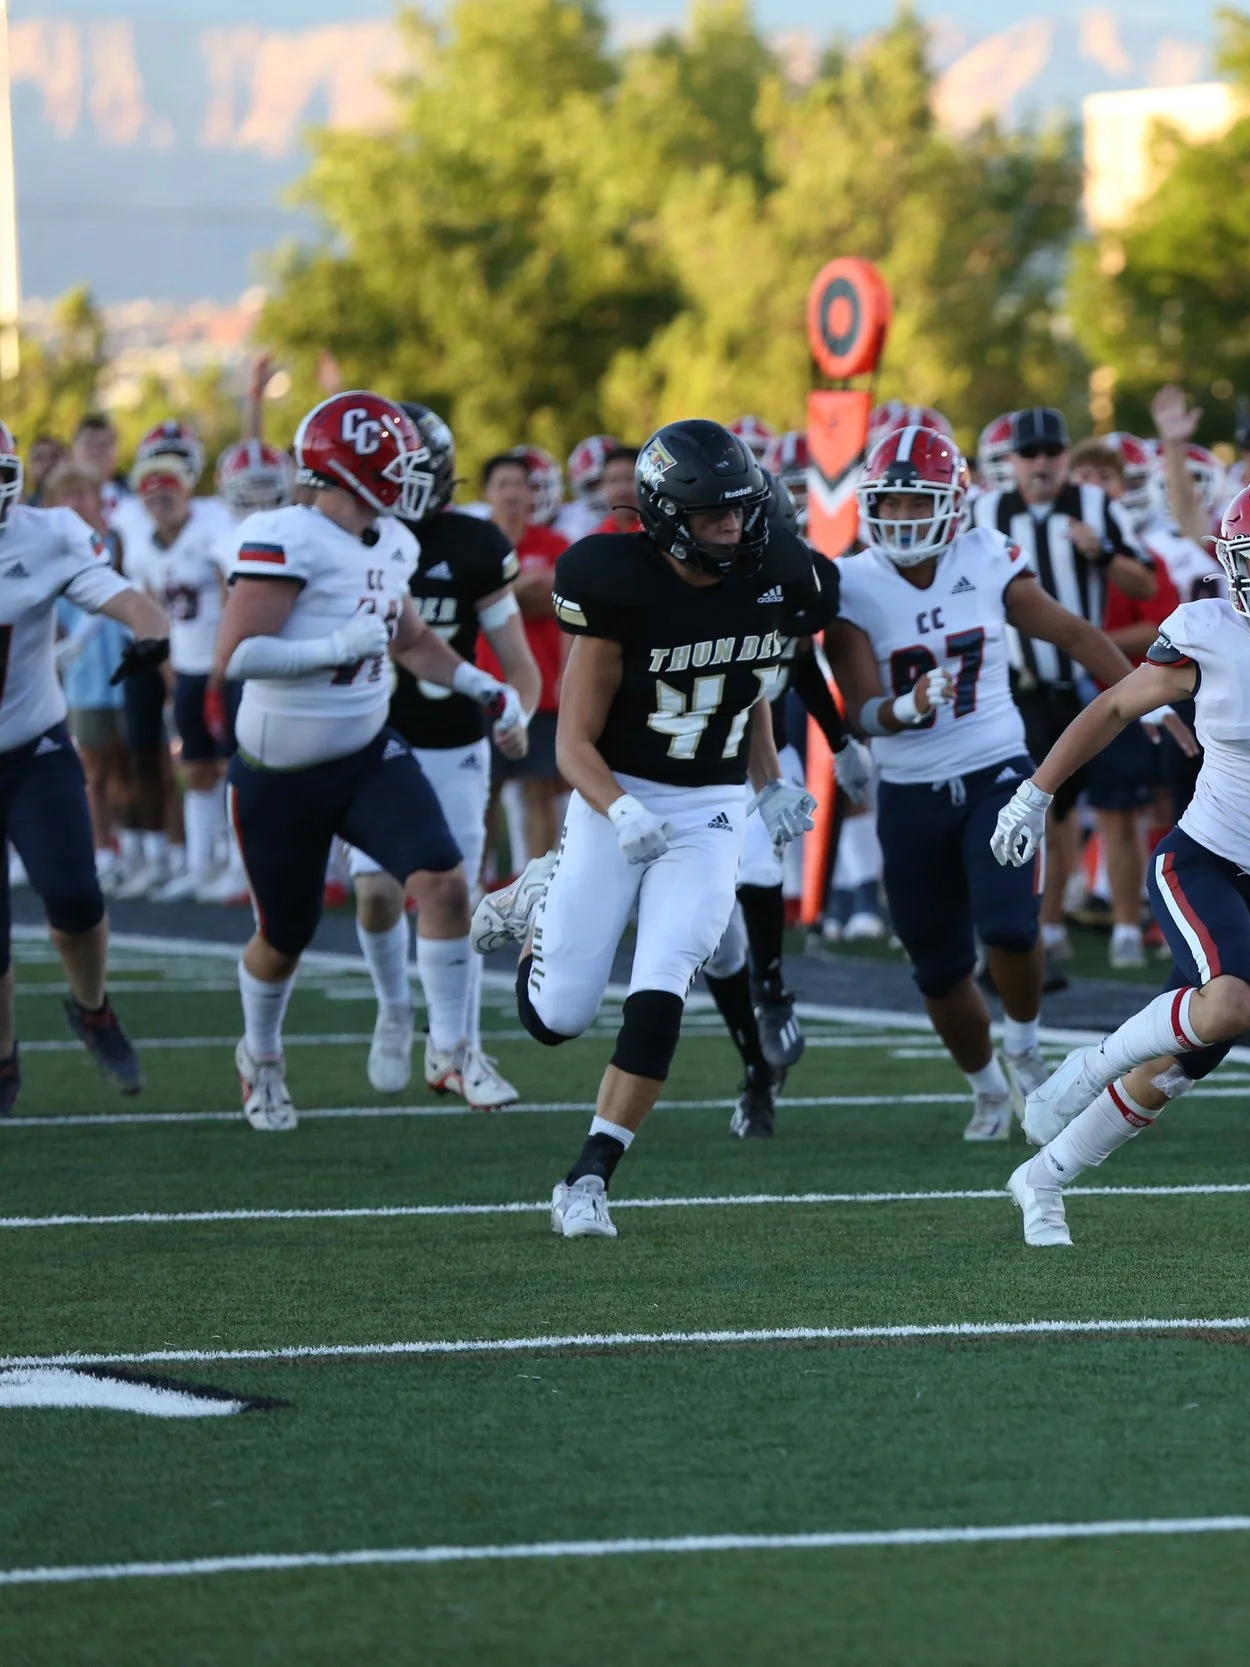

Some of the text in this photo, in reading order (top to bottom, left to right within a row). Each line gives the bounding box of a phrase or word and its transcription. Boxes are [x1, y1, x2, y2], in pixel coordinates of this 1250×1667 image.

[342, 408, 380, 454] CC
[725, 485, 752, 498] Riddell
[915, 606, 946, 635] CC
